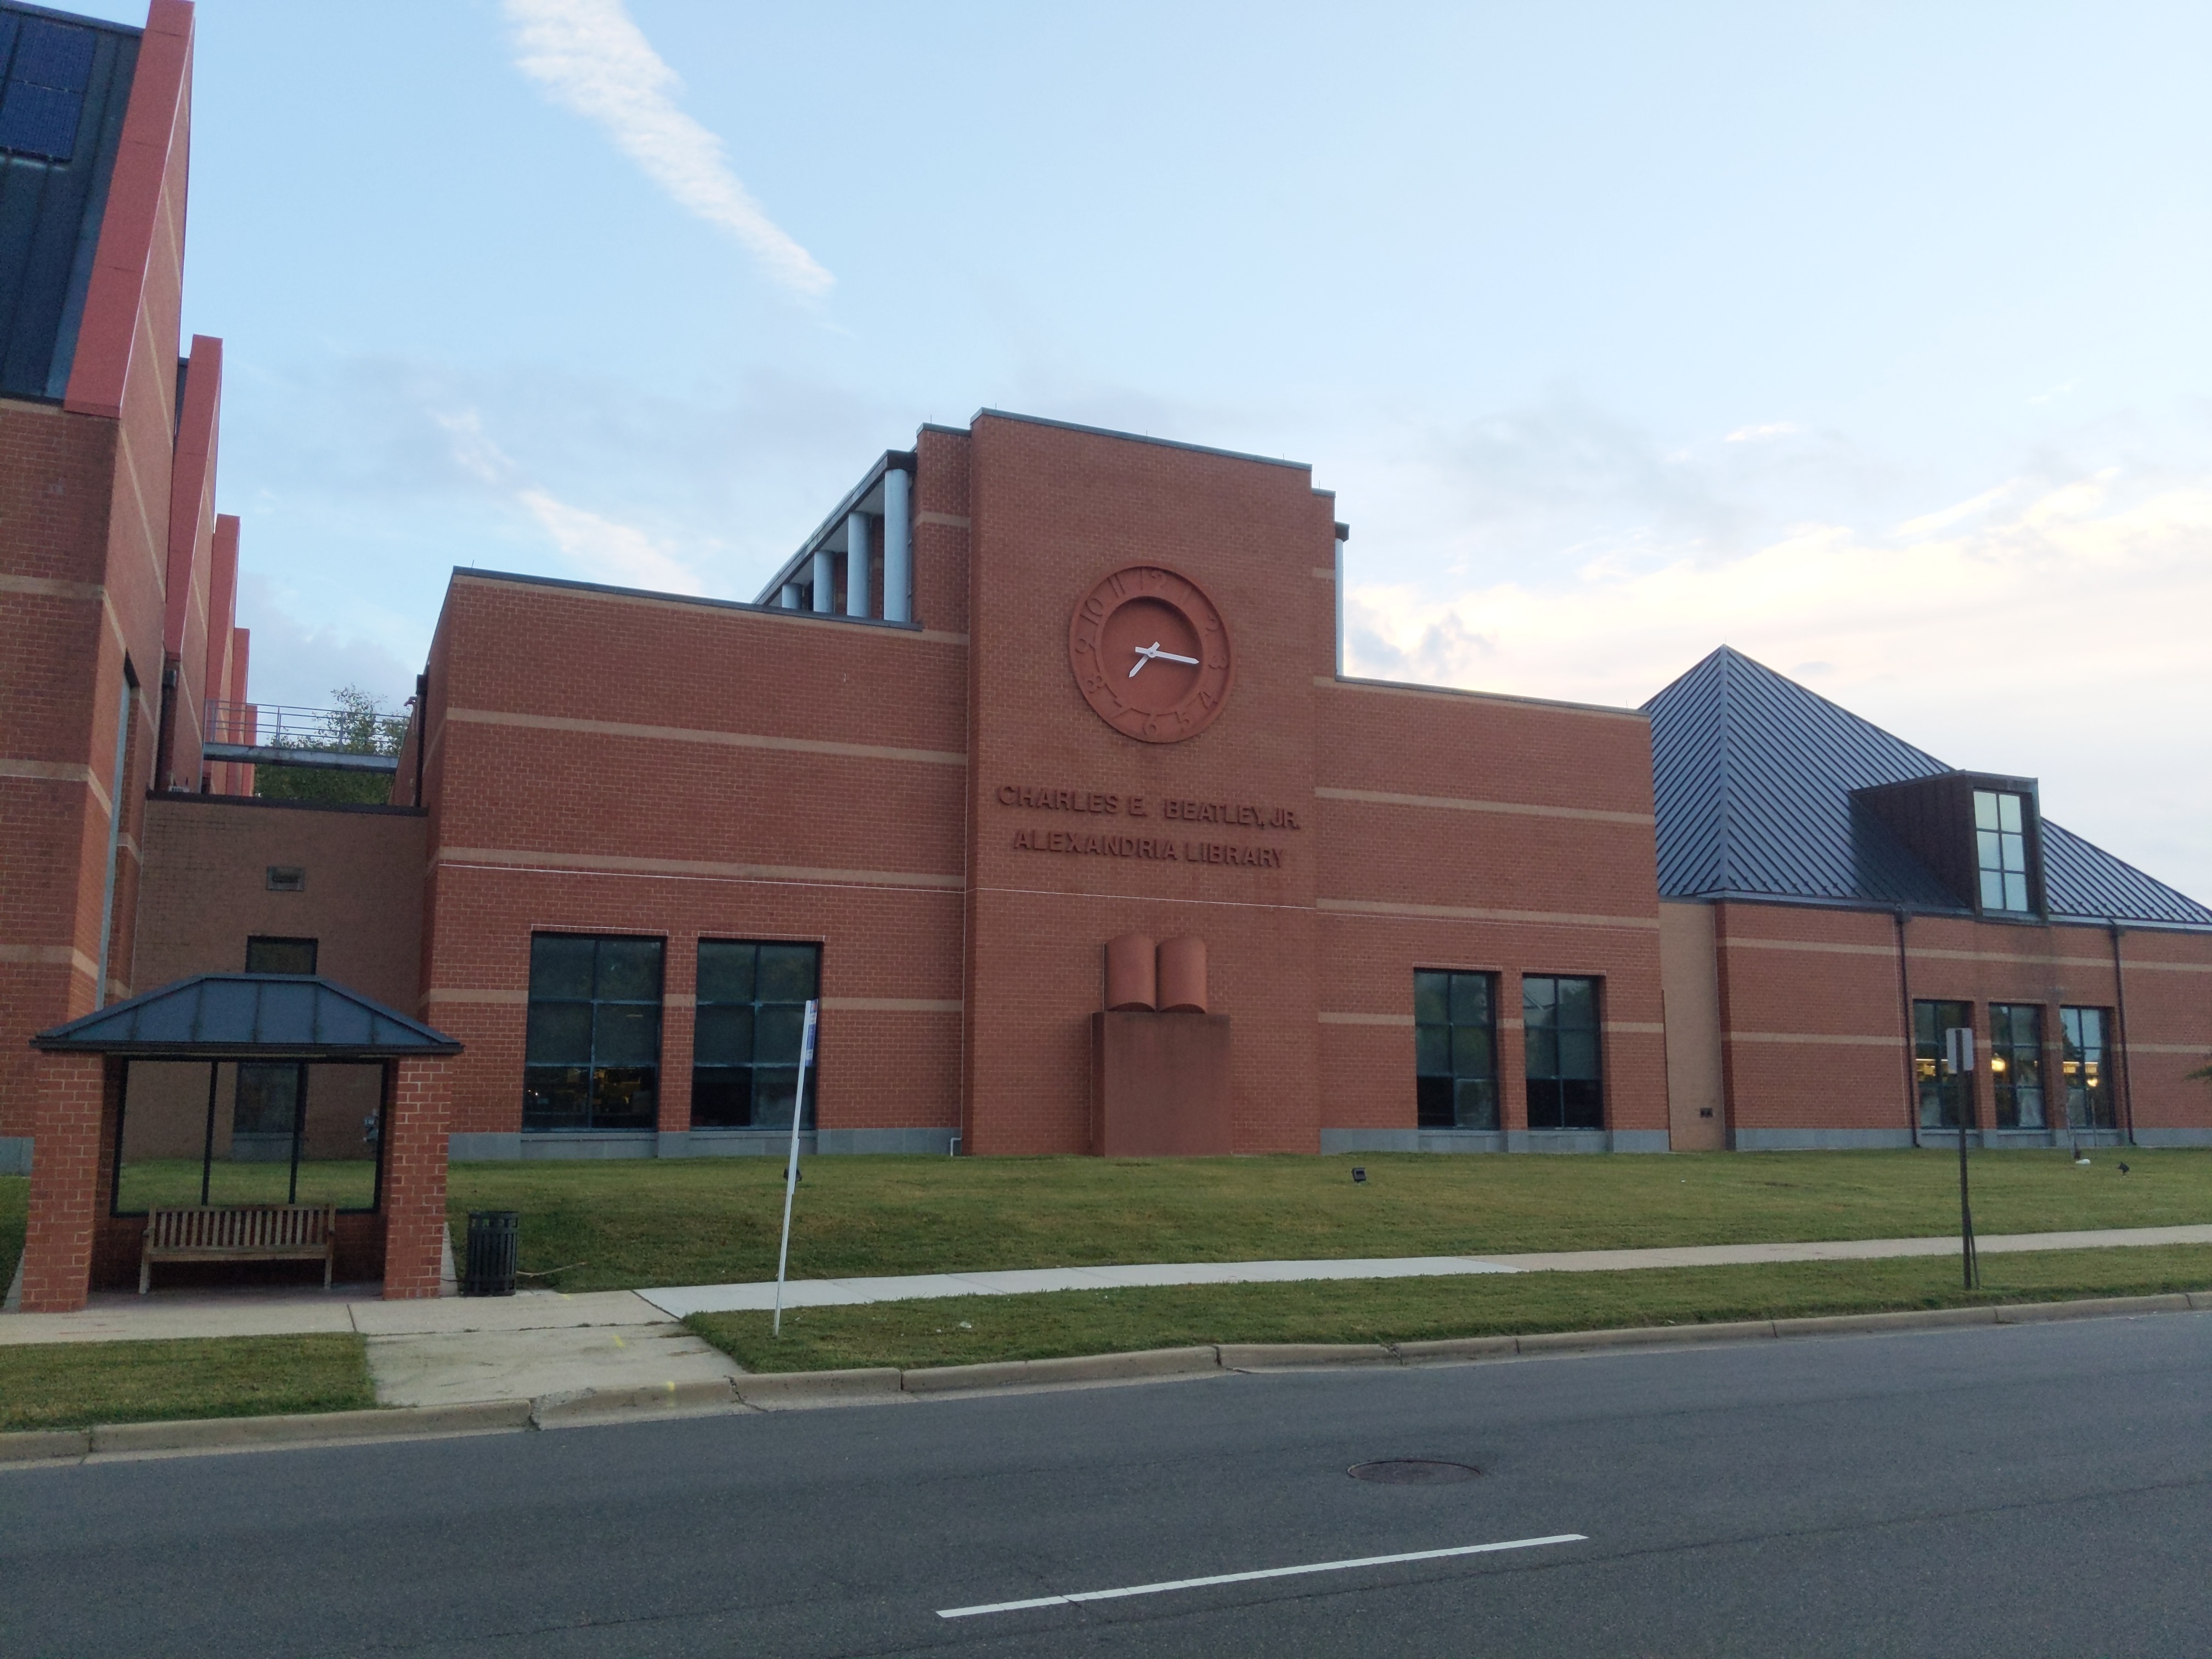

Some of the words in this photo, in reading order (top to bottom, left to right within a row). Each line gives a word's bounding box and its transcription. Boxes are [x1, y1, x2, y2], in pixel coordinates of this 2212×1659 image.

[1080, 597, 1103, 625] 10
[998, 785, 1119, 814] CHARLES
[1128, 794, 1147, 816] E.
[1164, 799, 1265, 829] BEATLEY,
[1271, 808, 1301, 830] JR.
[1014, 829, 1178, 860] ALEXANDRIA
[1186, 841, 1283, 868] LIBRARY
